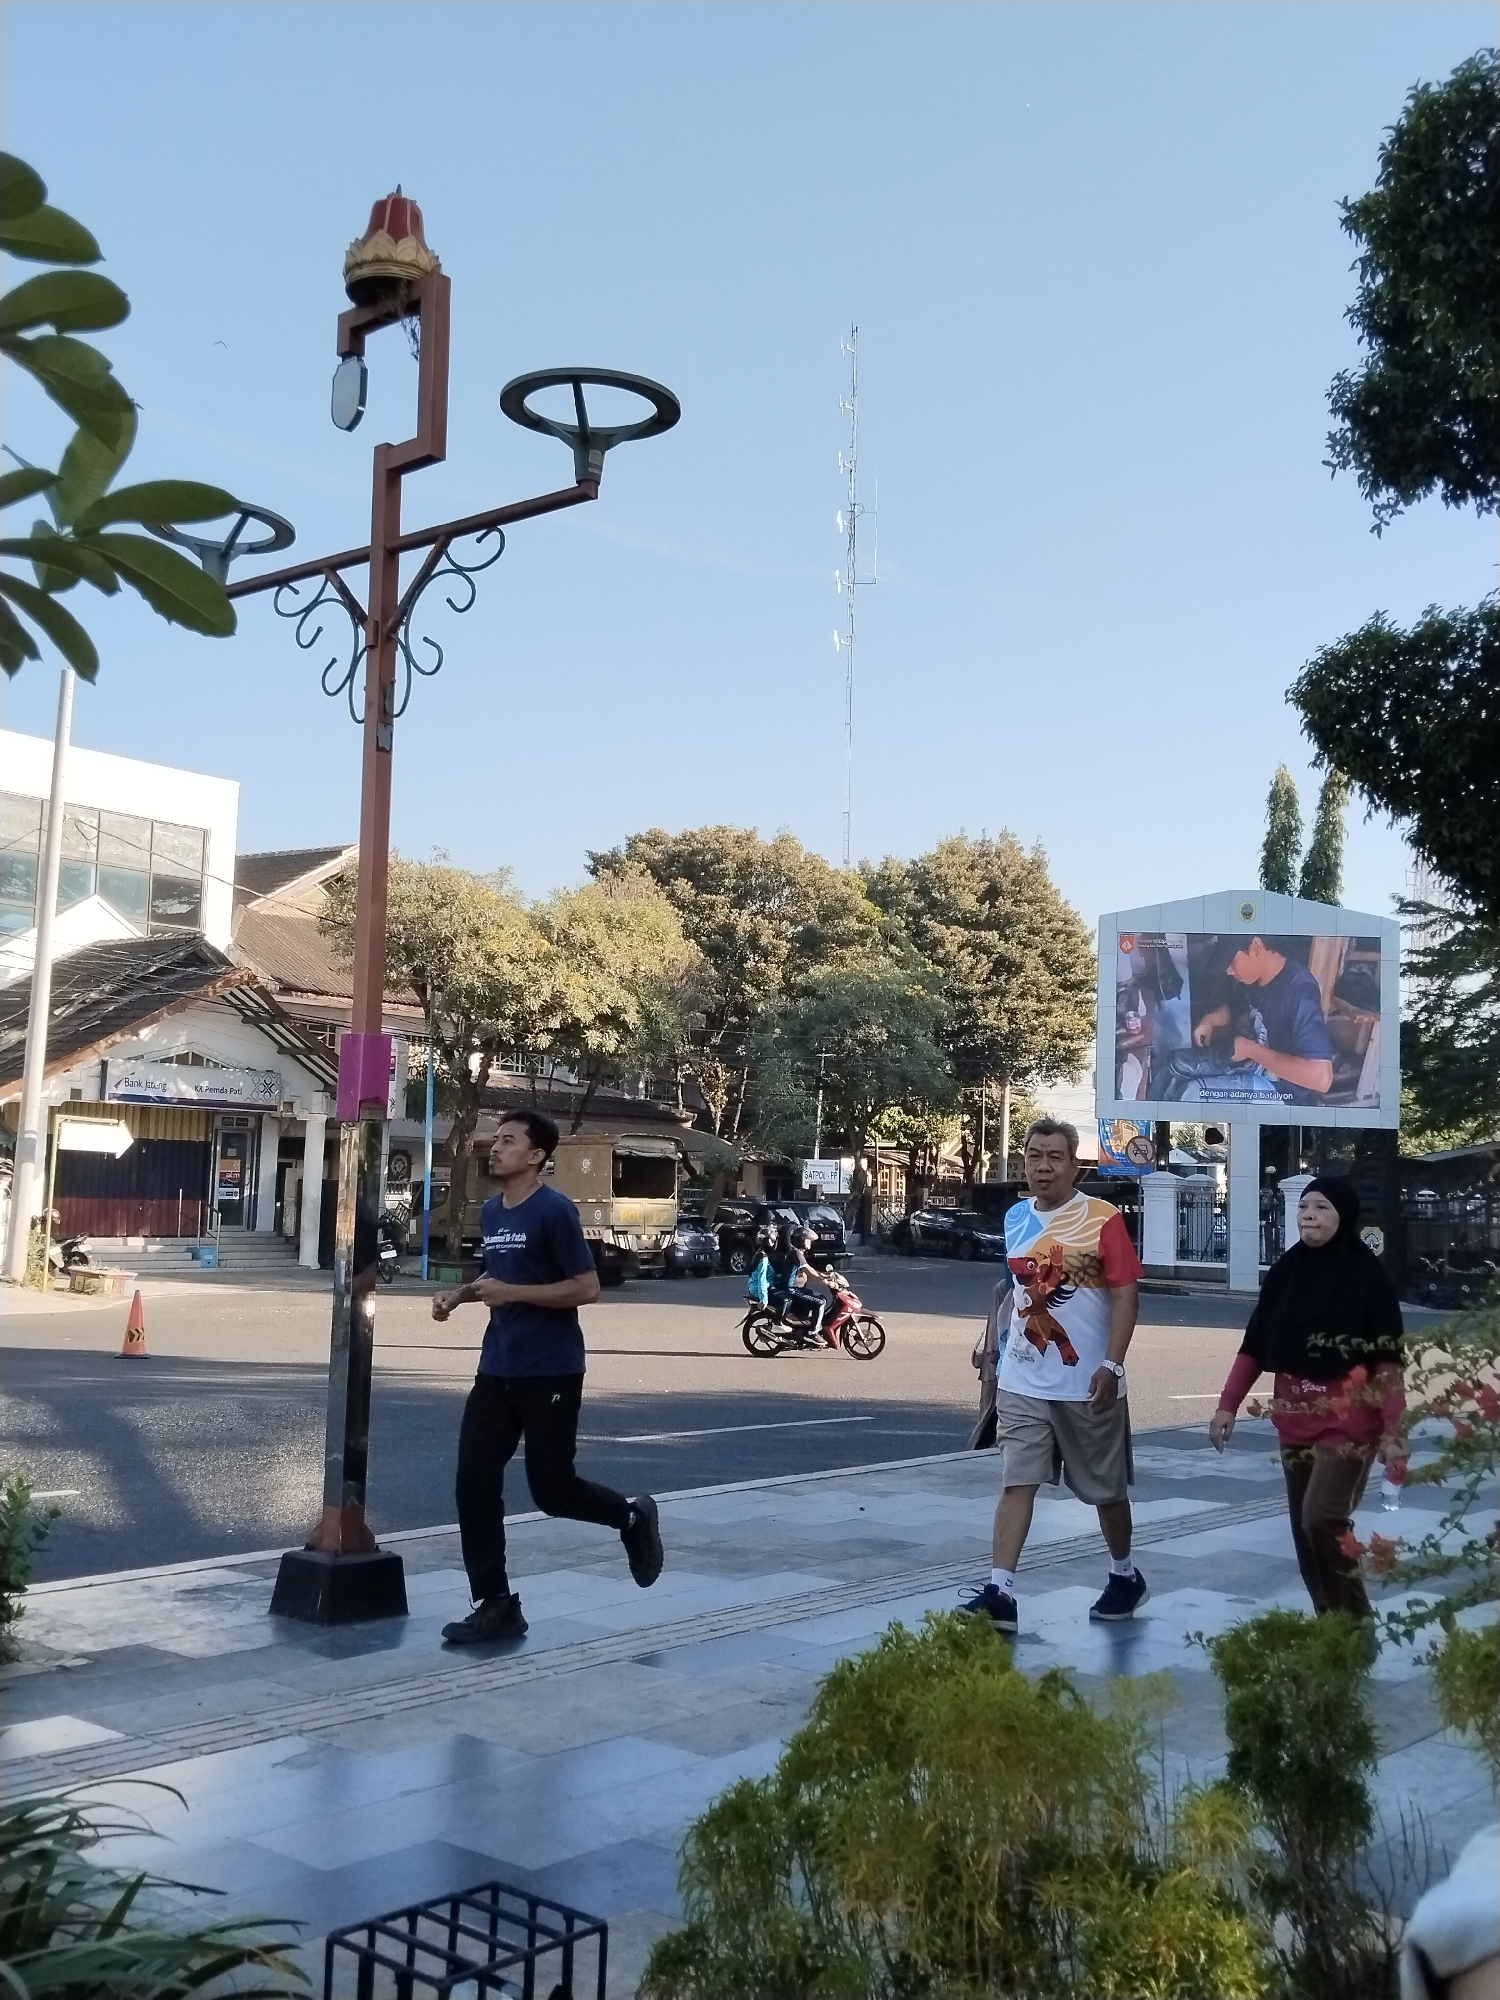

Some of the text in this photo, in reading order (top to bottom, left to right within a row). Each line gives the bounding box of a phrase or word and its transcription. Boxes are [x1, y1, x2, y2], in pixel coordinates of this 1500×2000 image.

[124, 1078, 168, 1092] Bank Jateng
[204, 1086, 228, 1095] Pemda
[230, 1088, 243, 1096] Pati
[1200, 1089, 1294, 1100] dengan adanya batalyon
[804, 1170, 826, 1180] SATPOL
